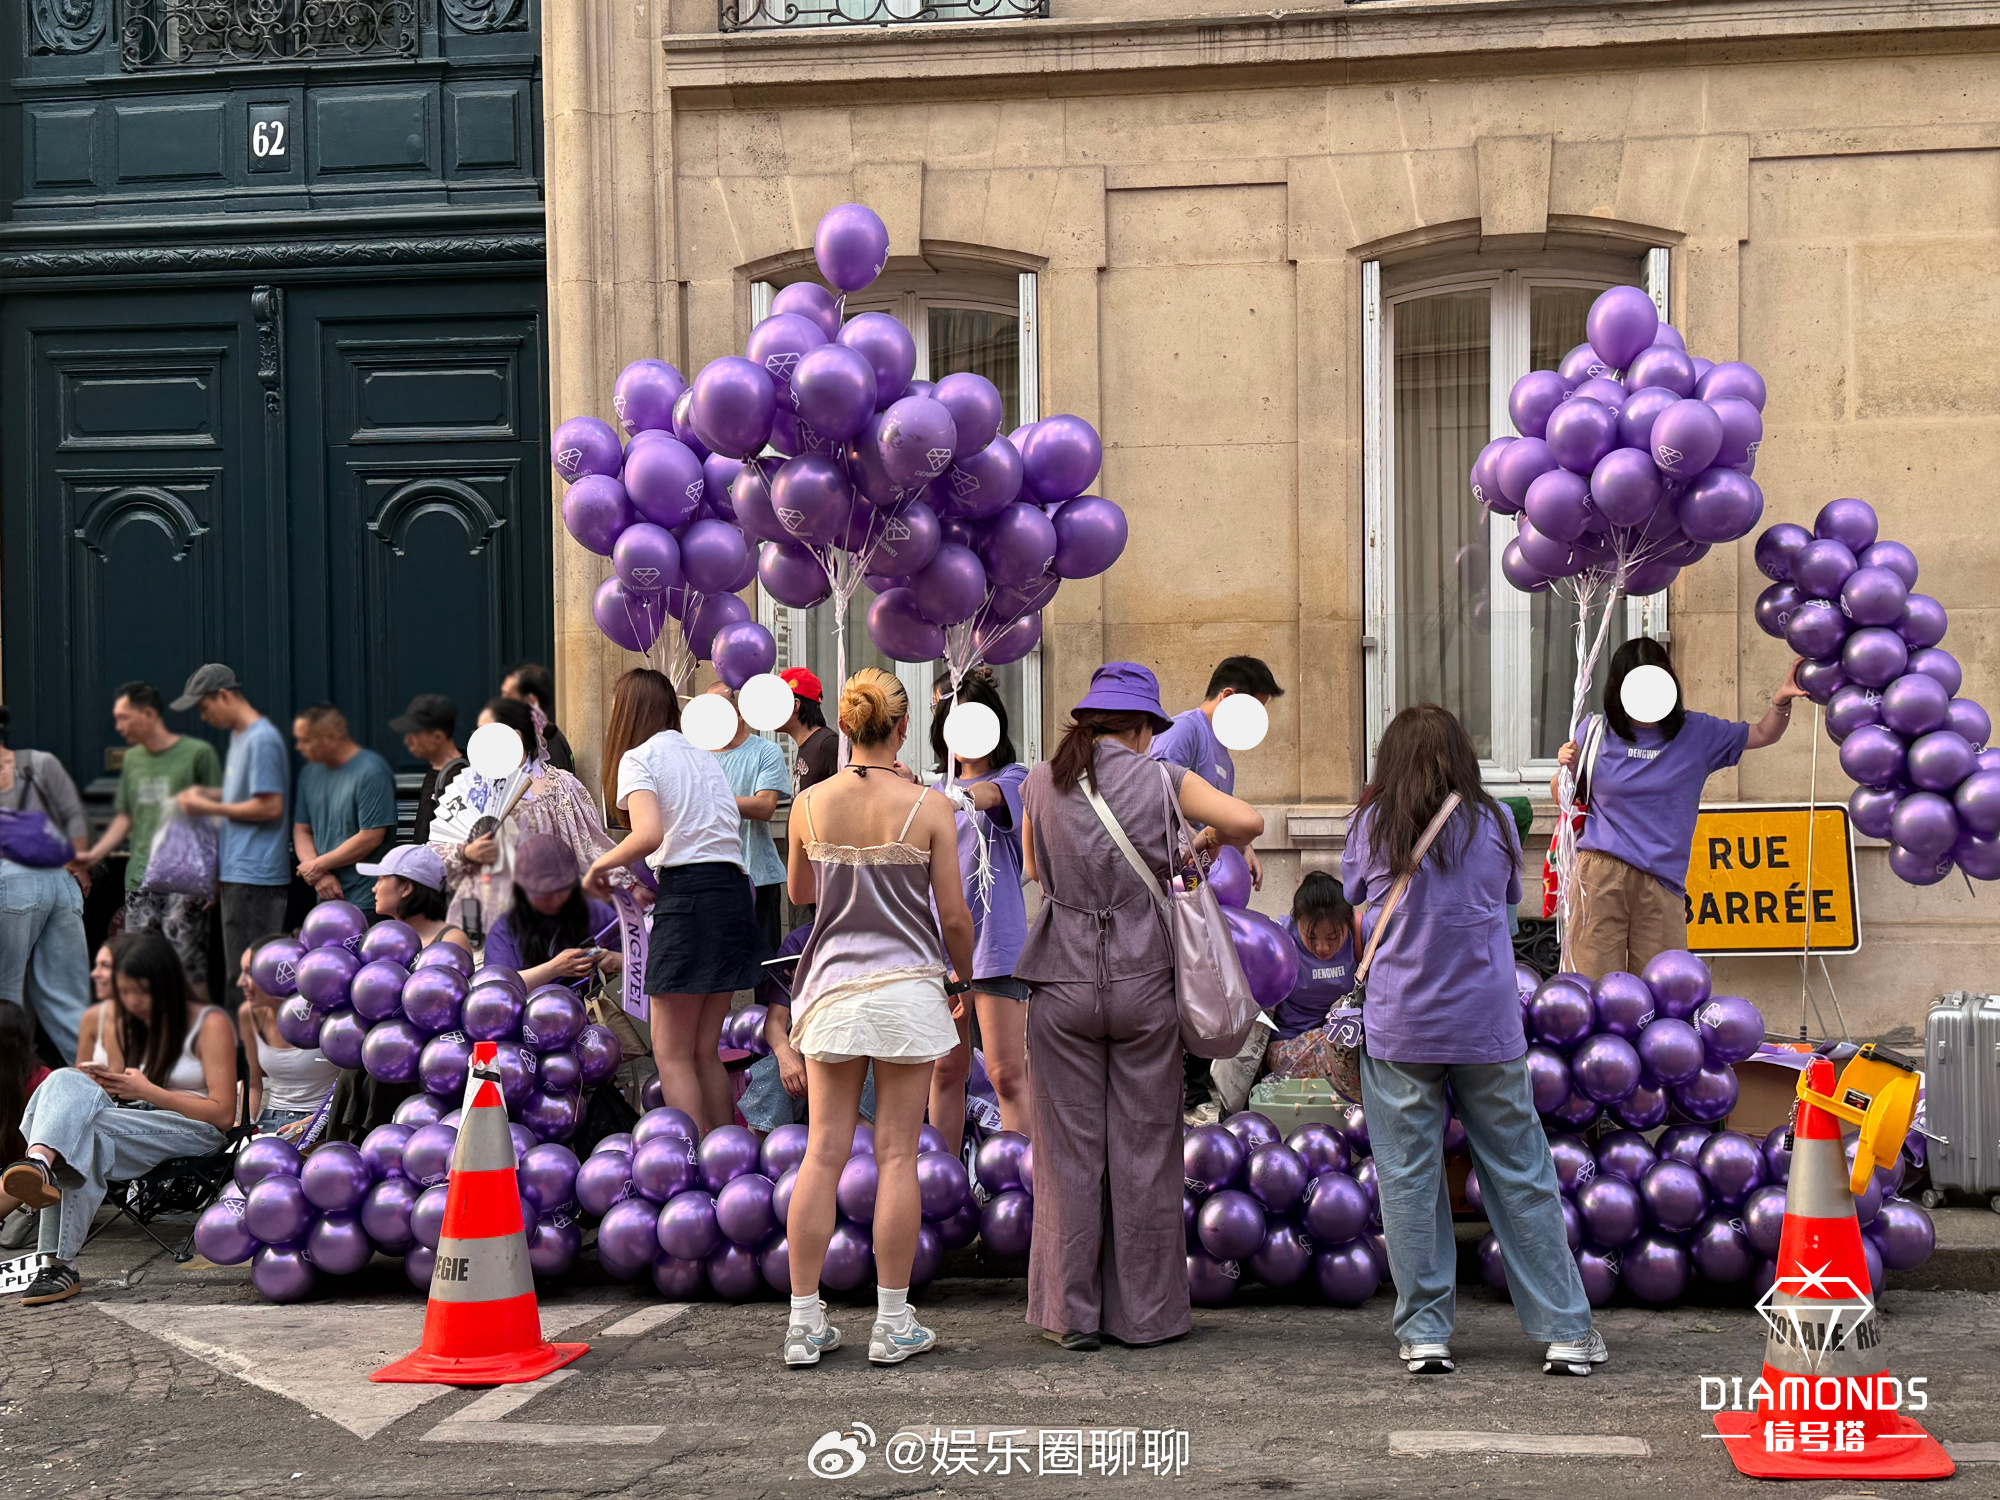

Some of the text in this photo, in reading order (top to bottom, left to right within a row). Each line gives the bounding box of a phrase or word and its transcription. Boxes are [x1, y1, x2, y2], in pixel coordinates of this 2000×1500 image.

[253, 120, 285, 158] 62
[1627, 748, 1661, 760] DENGWE
[1708, 836, 1789, 870] RUE
[1312, 965, 1345, 980] DENGWEI
[1769, 1312, 1845, 1352] TOTALE
